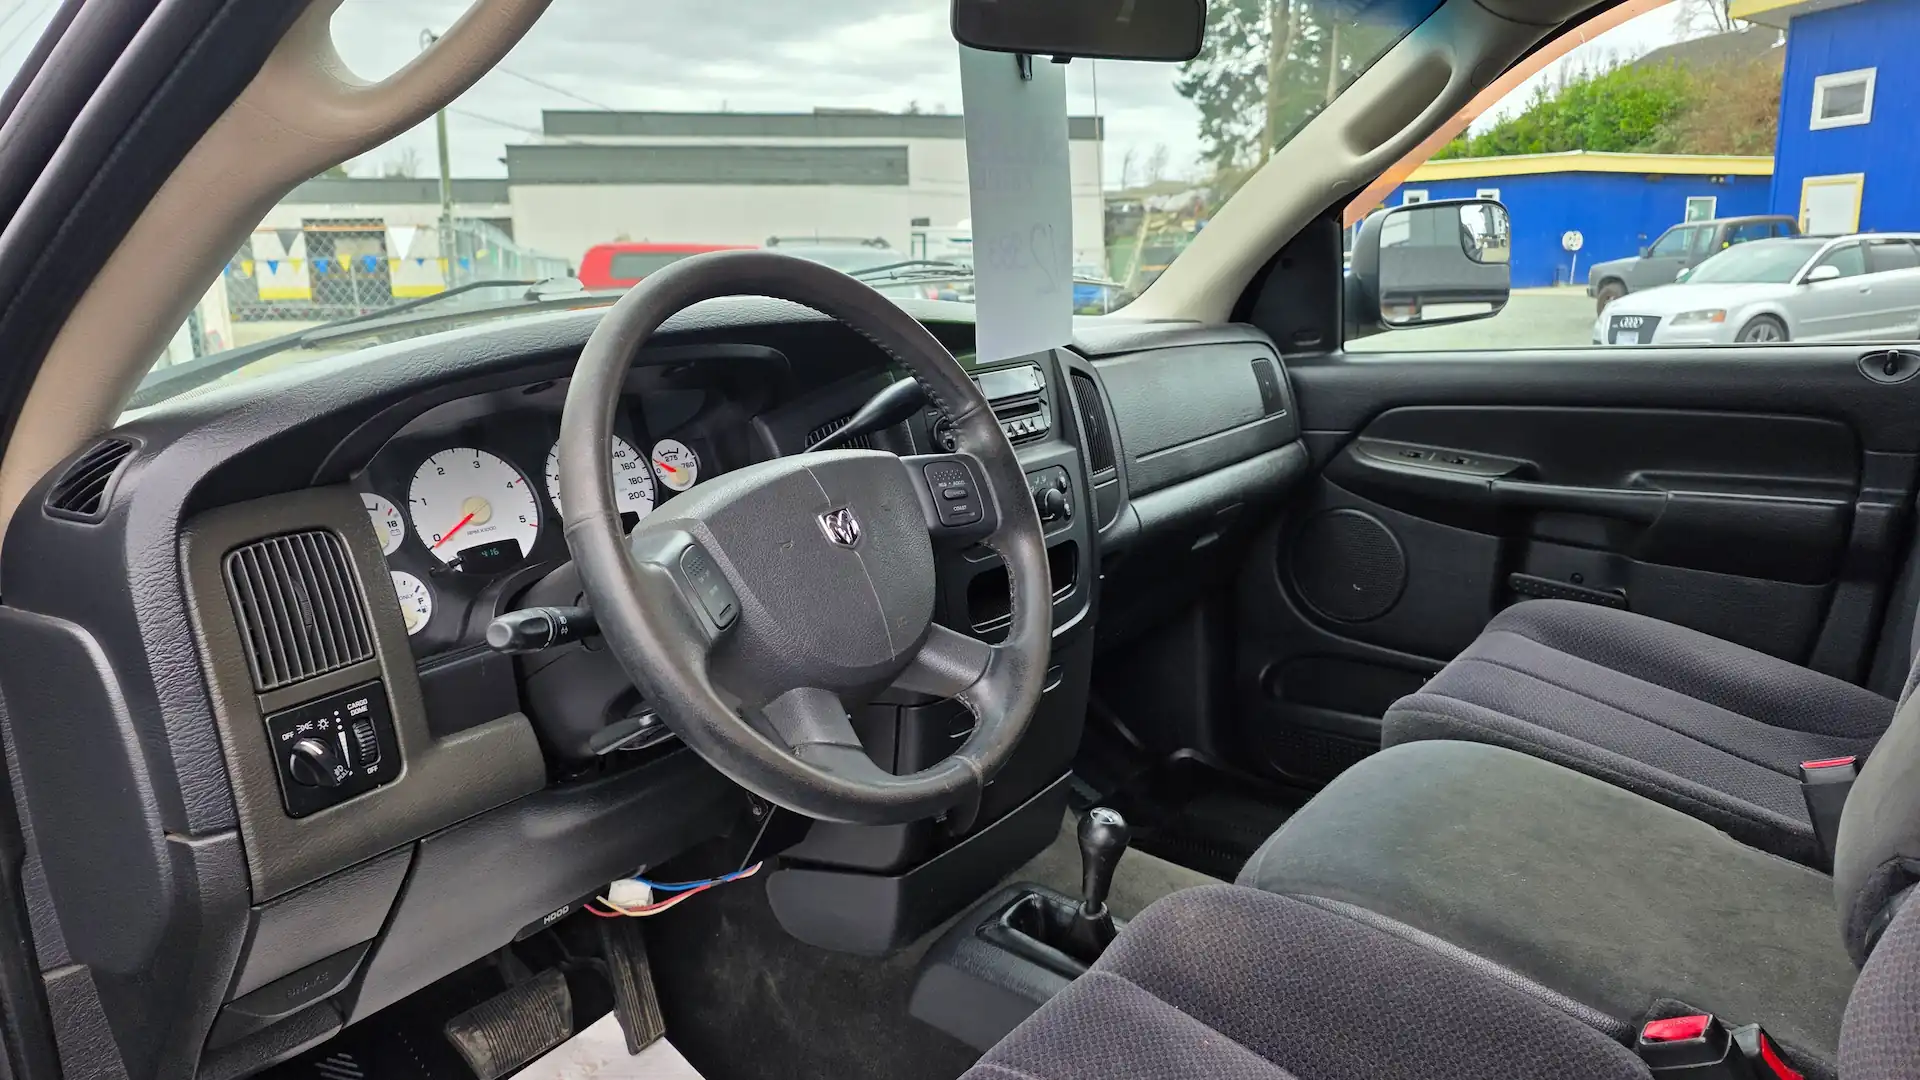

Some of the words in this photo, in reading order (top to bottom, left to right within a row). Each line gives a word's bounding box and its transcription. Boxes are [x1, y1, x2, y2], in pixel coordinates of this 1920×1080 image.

[612, 450, 626, 459] 40
[472, 460, 481, 469] 3
[621, 461, 636, 471] 160
[437, 467, 446, 476] 2
[506, 481, 514, 489] 4
[628, 476, 644, 485] 180
[628, 490, 646, 500] 200
[421, 498, 427, 506] 1
[519, 515, 527, 523] 5
[387, 520, 398, 528] 18
[433, 533, 441, 542] 0
[346, 698, 368, 710] CARGO
[350, 705, 368, 717] DOME
[281, 731, 295, 741] OFF
[366, 764, 379, 775] OFF
[543, 904, 570, 925] HOOD
